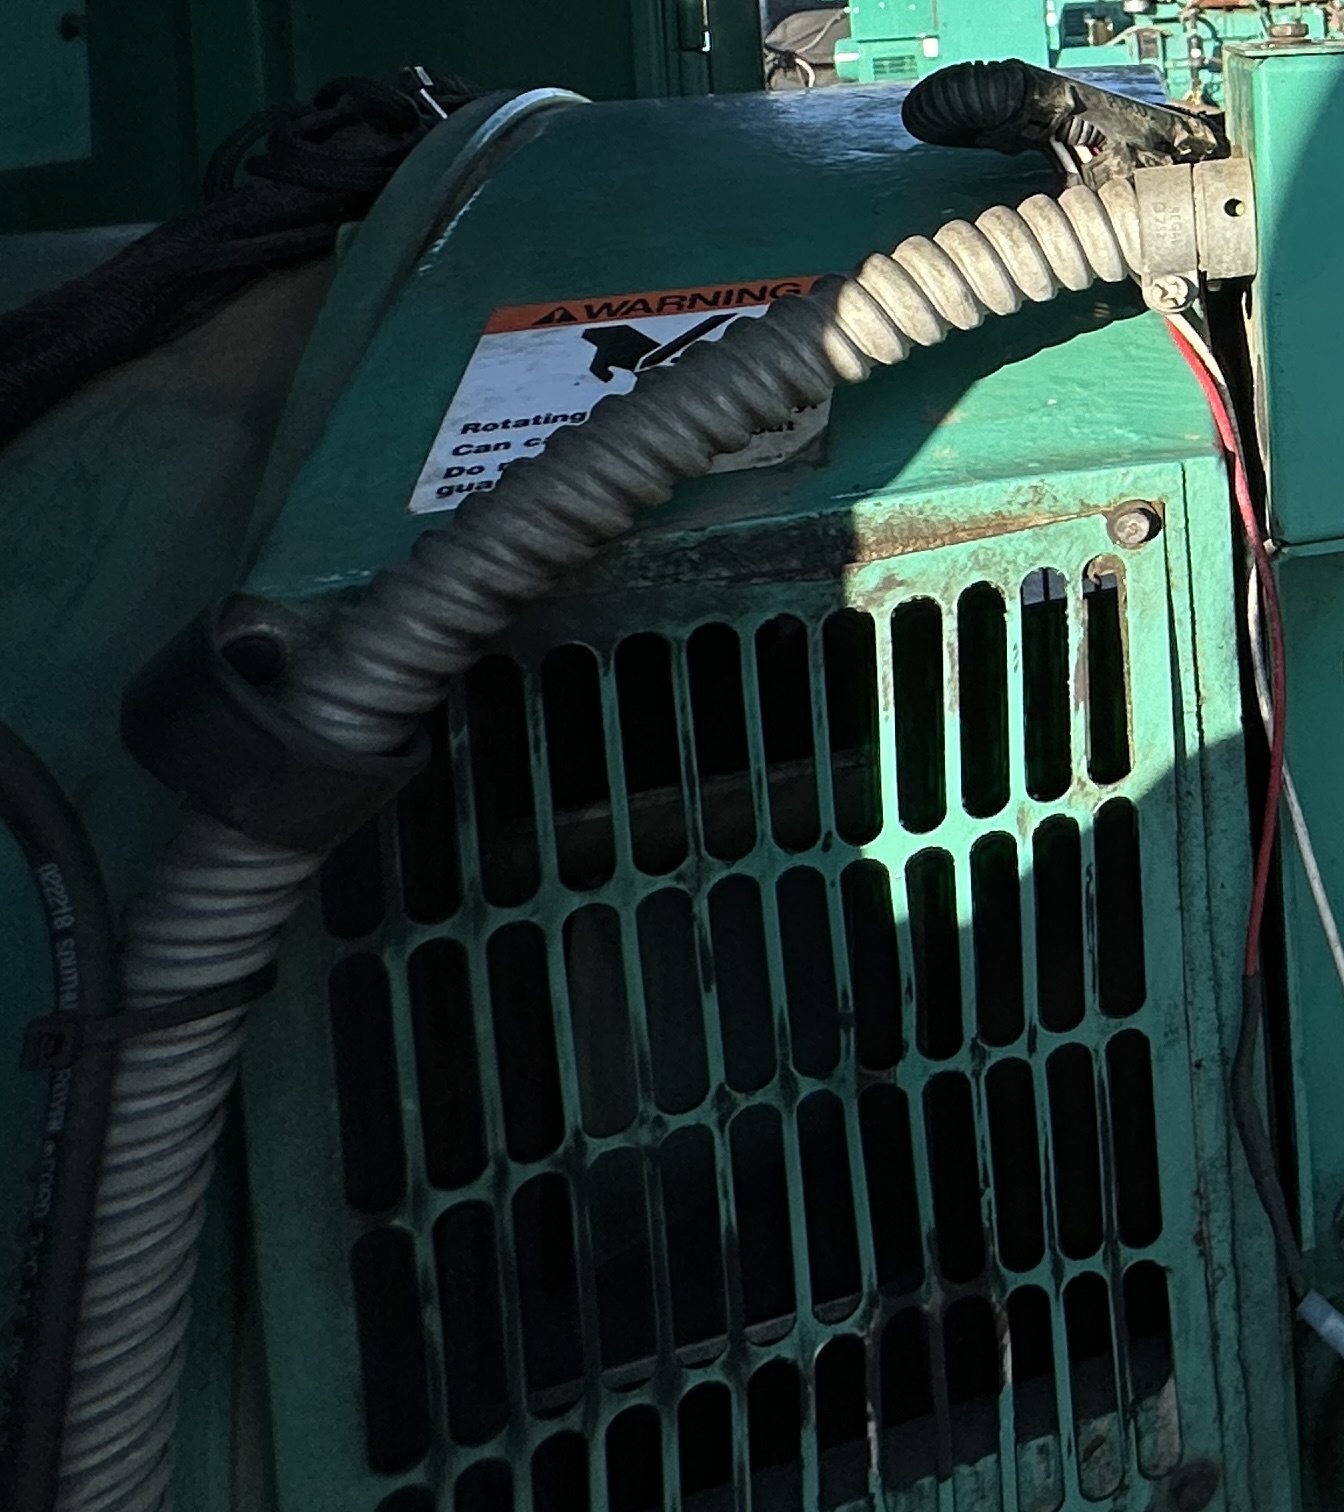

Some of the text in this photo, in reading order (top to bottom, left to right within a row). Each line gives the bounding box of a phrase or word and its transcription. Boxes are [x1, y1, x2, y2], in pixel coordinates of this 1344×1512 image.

[584, 282, 802, 319] WARNING
[461, 411, 588, 434] Rotating
[452, 440, 512, 456] Can
[443, 464, 485, 479] Do
[435, 480, 493, 499] gua
